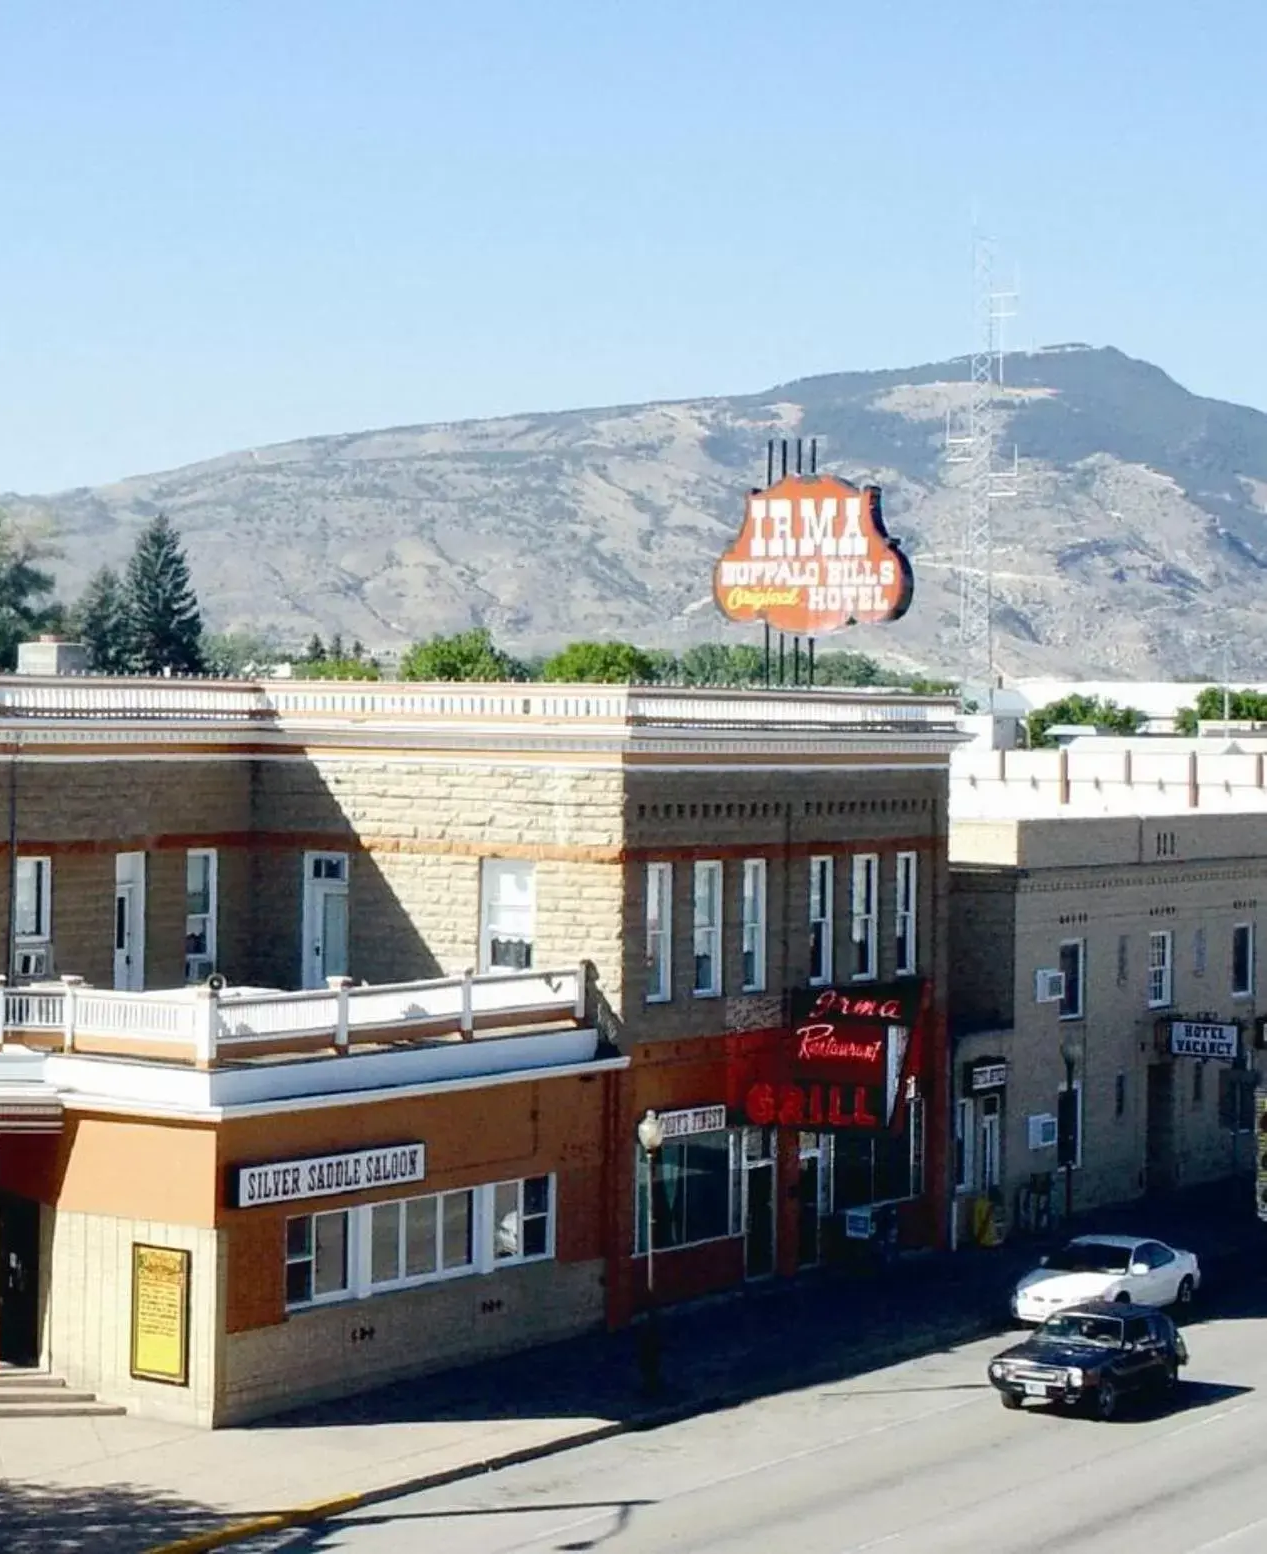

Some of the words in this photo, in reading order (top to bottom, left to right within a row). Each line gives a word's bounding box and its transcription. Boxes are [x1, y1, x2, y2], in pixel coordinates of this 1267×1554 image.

[749, 498, 869, 557] IRMA
[721, 561, 820, 586] BUFFALO
[727, 586, 801, 610] Original
[808, 586, 889, 612] HOTEL
[808, 989, 902, 1019] Irma
[796, 1023, 882, 1062] Restaurant
[1184, 1024, 1228, 1040] HOTEL
[1176, 1039, 1233, 1055] VACANCY
[746, 1081, 877, 1125] GRILL
[247, 1167, 301, 1201] SILVER
[307, 1158, 362, 1192] SADDLE
[365, 1149, 419, 1183] SALOON
